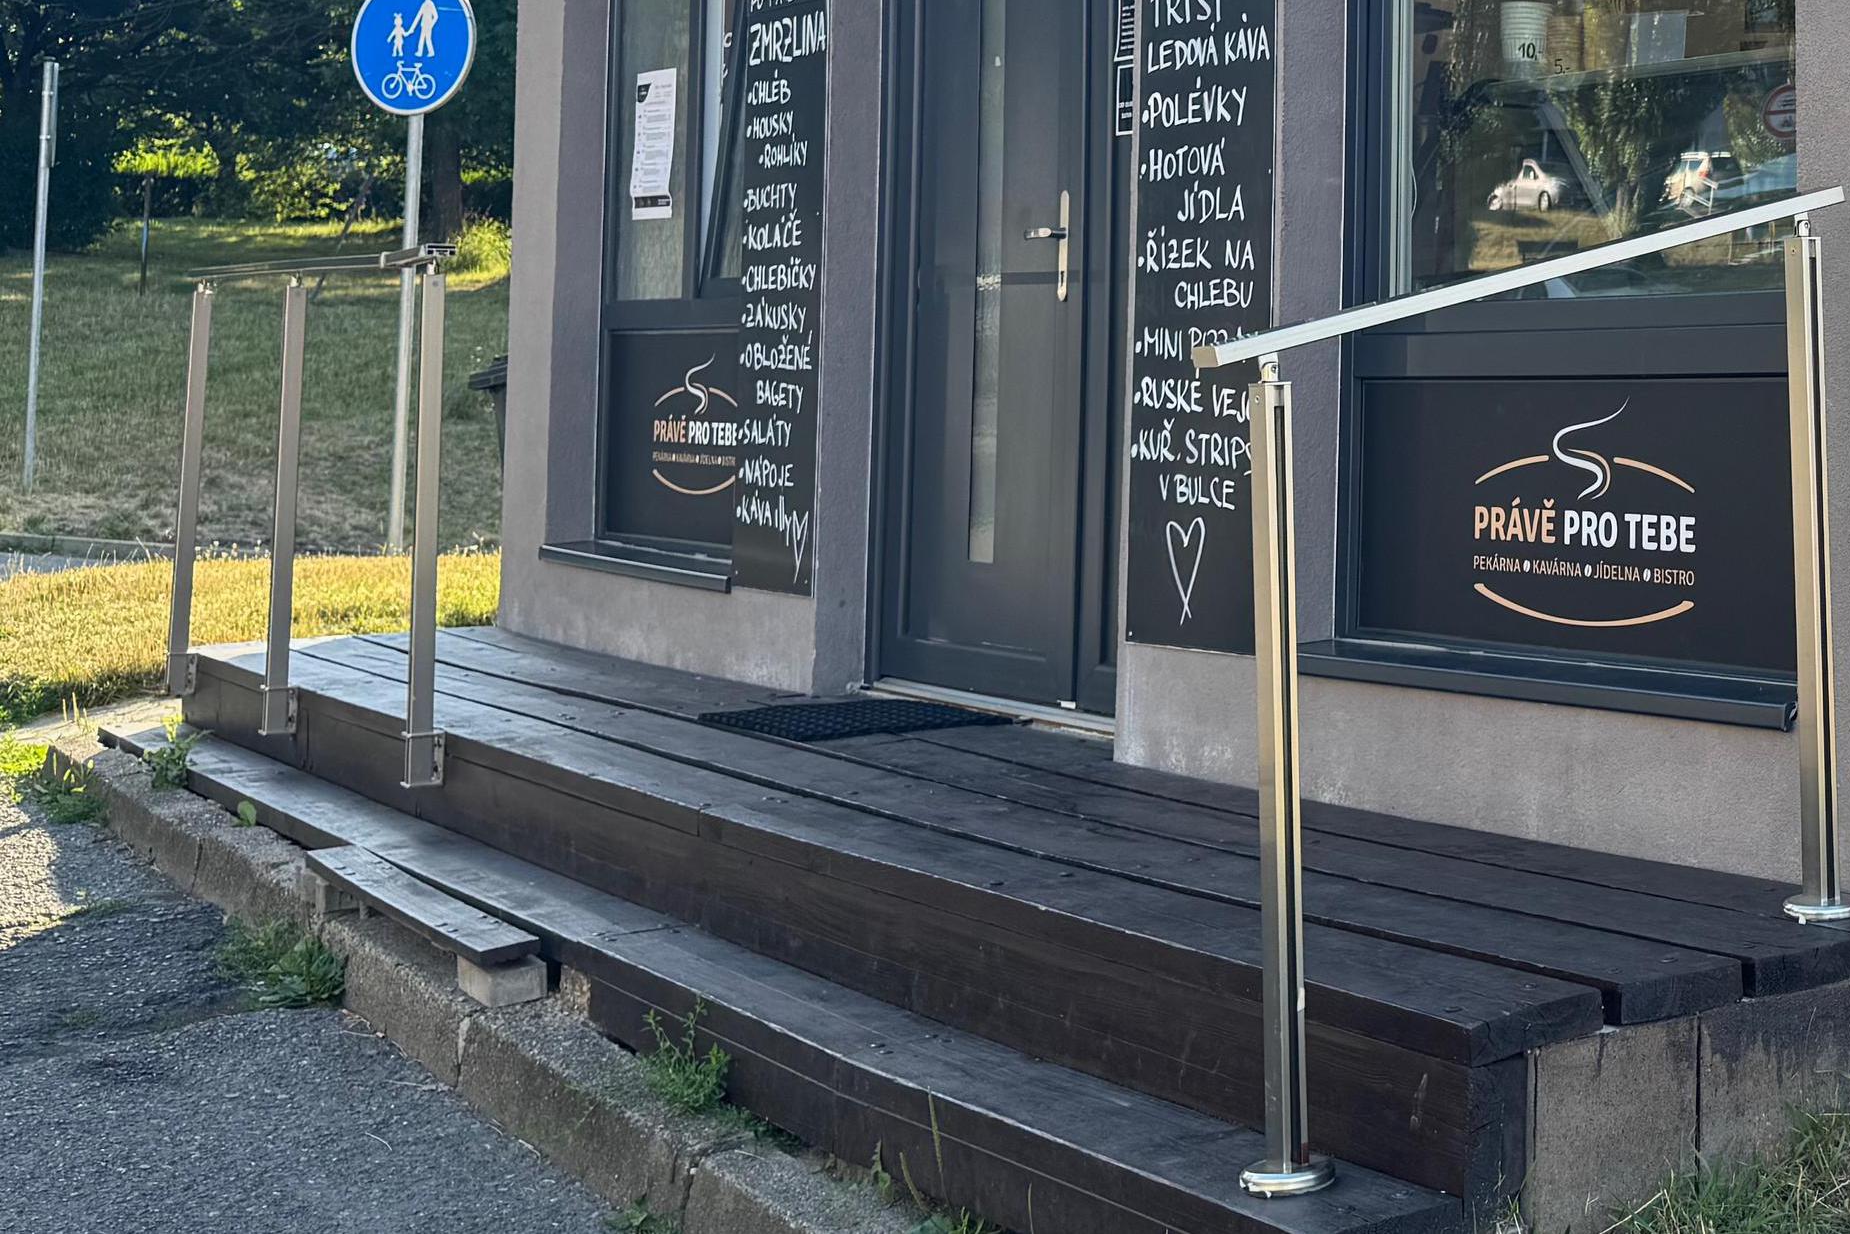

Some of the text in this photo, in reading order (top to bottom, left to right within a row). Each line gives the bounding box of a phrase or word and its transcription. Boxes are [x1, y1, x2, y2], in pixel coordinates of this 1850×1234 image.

[1213, 384, 1250, 423] VEJ
[654, 414, 737, 446] PRÁVĚ PRO TEBE
[1474, 497, 1696, 553] PRÁVĚ PRO TEBE
[1474, 554, 1694, 586] PEKÁRNA KAVÁRNA JÍDELNA BISTRO
